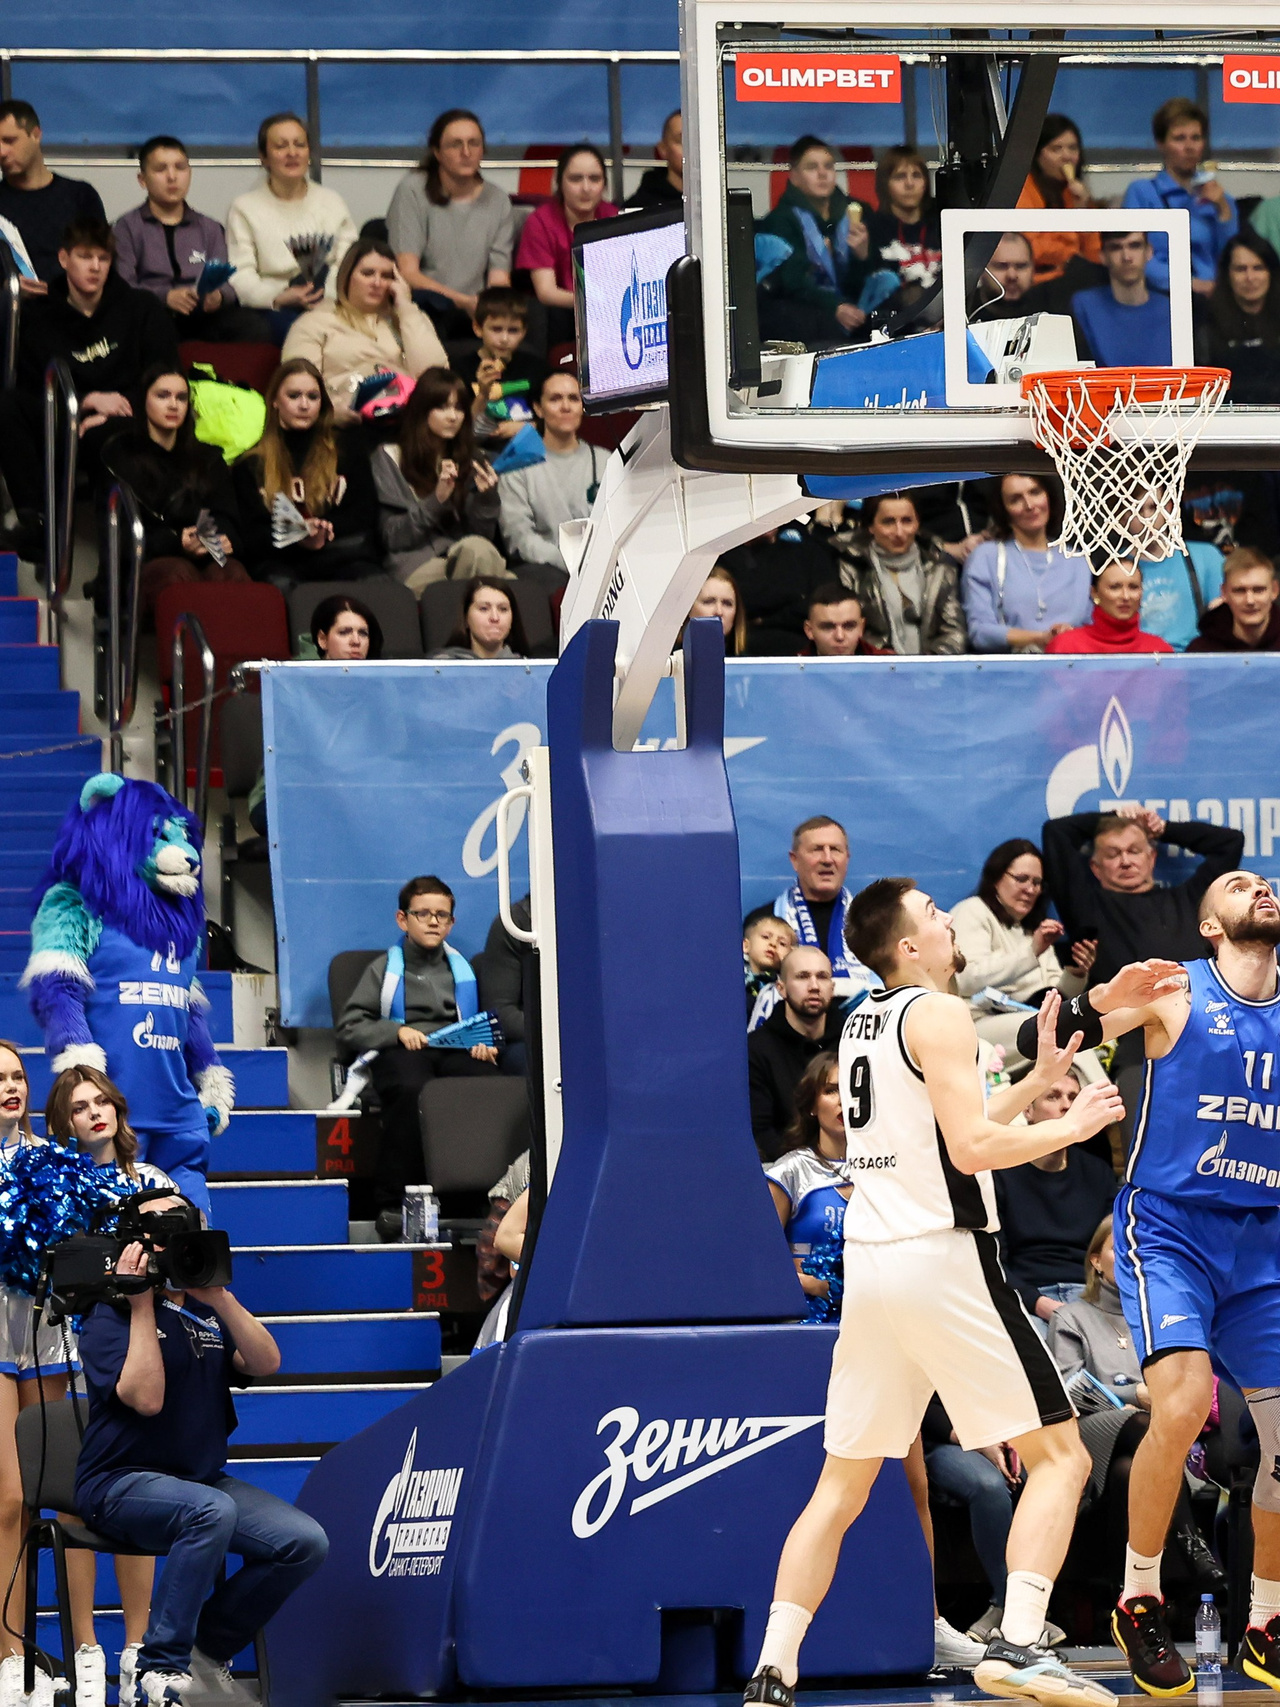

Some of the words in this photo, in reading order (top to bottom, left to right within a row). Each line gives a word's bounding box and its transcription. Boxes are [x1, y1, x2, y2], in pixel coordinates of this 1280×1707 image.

[742, 67, 894, 88] OLIMPBET
[1208, 1028, 1235, 1036] KELME
[1243, 1050, 1274, 1090] 11
[849, 1055, 873, 1130] 9
[326, 1117, 354, 1155] 4
[325, 1159, 355, 1173] РЯД
[104, 1256, 112, 1270] 3
[421, 1250, 446, 1289] 3
[417, 1292, 448, 1307] РЯД
[571, 1406, 827, 1539] Зенит
[402, 1467, 464, 1519] ГАЗПРОМ
[397, 1526, 448, 1548] ТРАНСГАЗ
[388, 1555, 445, 1577] САНКТ-ПЕТЕРБУРГ
